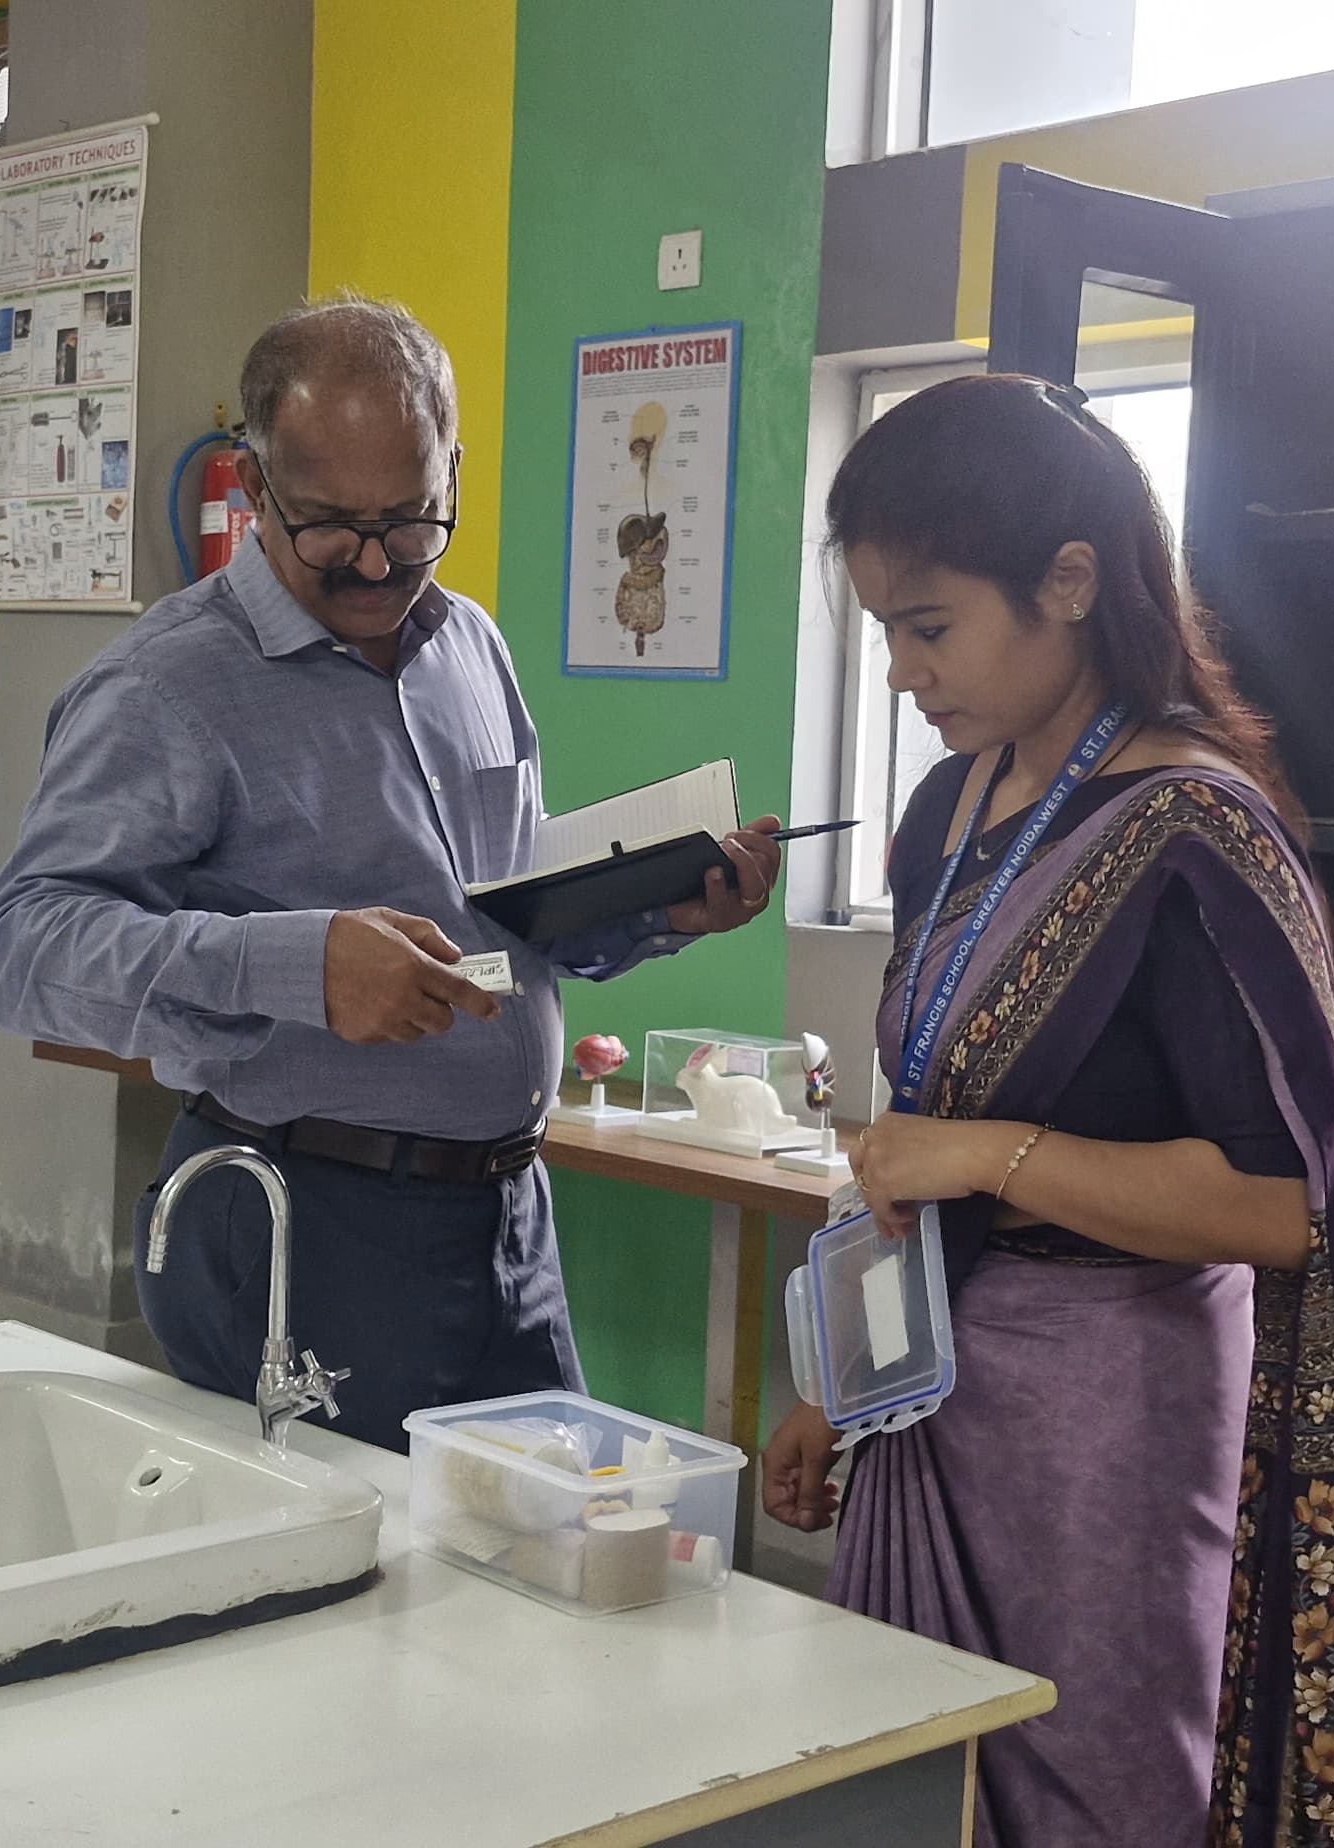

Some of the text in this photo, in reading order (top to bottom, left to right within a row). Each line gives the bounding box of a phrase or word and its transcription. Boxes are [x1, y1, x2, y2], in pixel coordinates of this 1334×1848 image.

[0, 139, 135, 181] LABORATORY TECHNIQUES
[582, 337, 727, 376] DIGESTIVE SYSTEM
[1080, 737, 1105, 759] ST.
[907, 781, 1068, 1081] ST. FRANCIS SCHOOL, GREATER NOIDA WEST
